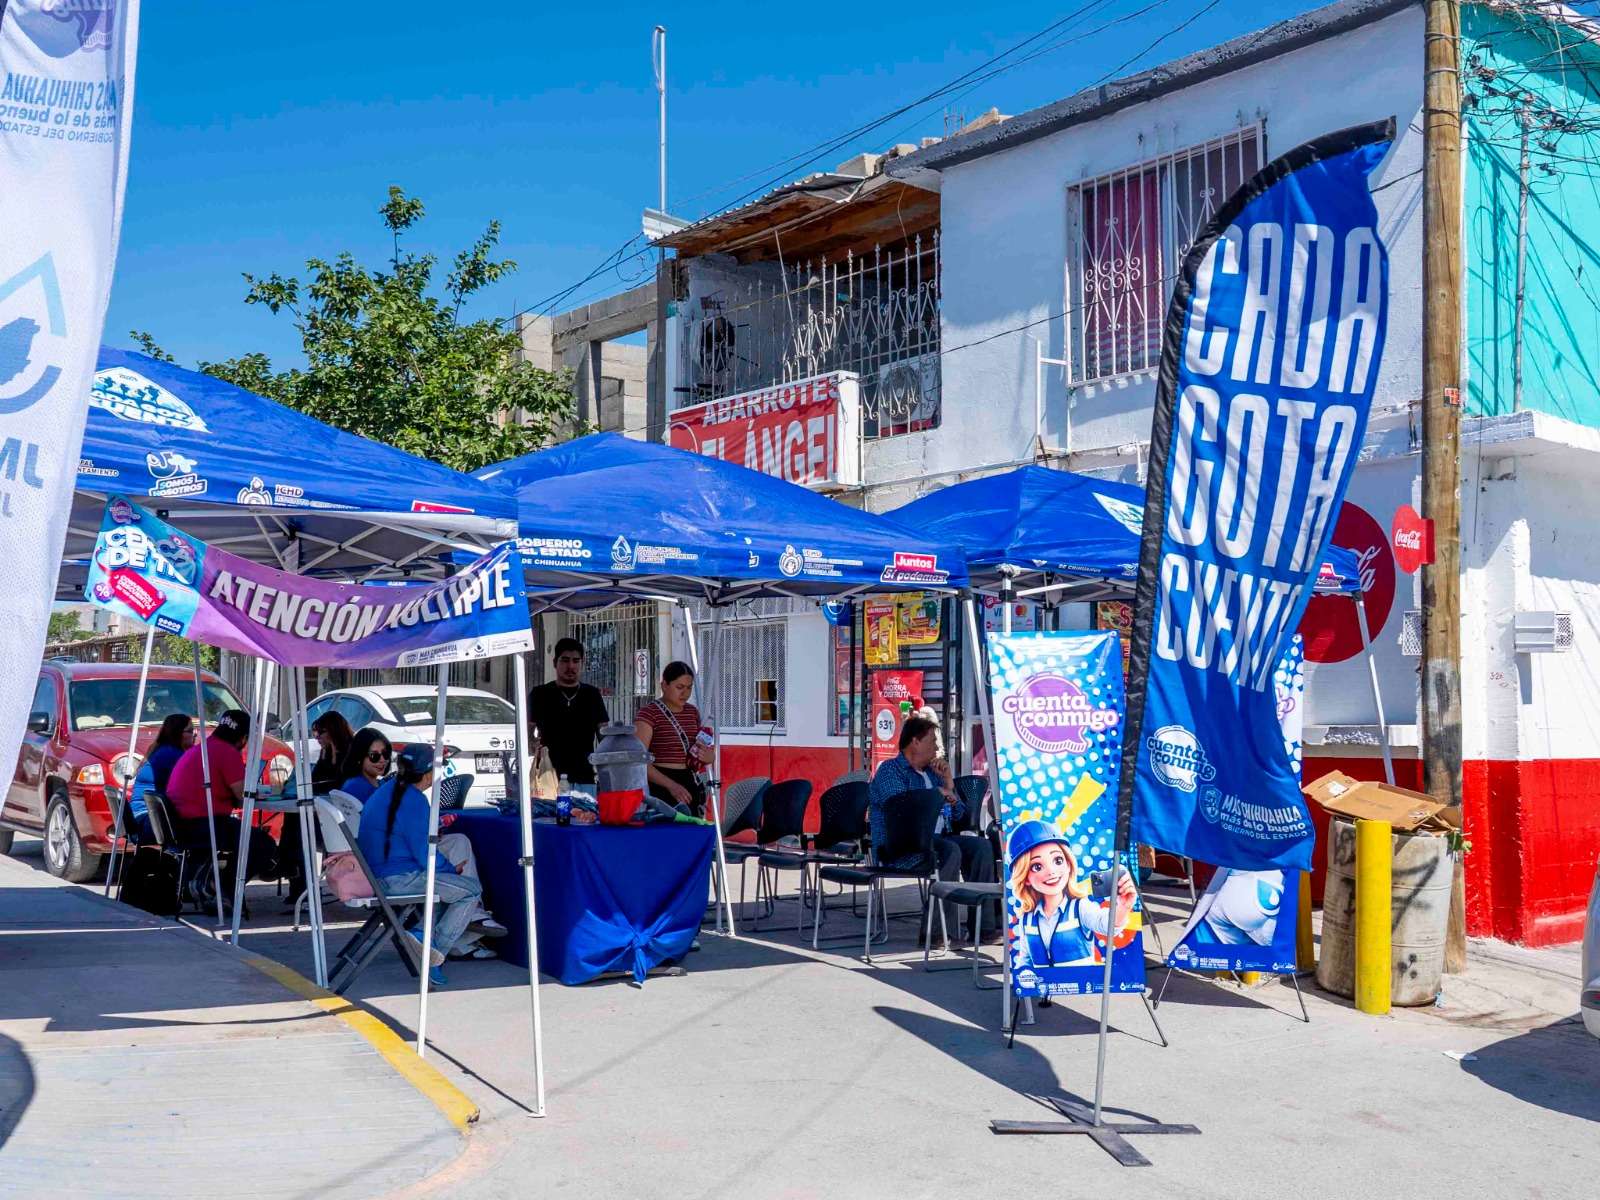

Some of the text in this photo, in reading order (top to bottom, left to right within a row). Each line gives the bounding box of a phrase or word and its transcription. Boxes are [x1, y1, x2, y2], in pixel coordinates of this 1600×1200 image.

[1185, 222, 1382, 394] CADA
[702, 374, 841, 427] ABARROTES
[744, 419, 839, 484] ÁNGEL
[1167, 385, 1358, 572] GOTA
[516, 538, 583, 549] GOBIERNO
[543, 548, 591, 558] ESTADO
[109, 549, 146, 568] DE
[522, 558, 582, 568] DE CHIHUAHUA
[897, 555, 932, 569] Juntos
[210, 570, 385, 643] ATENCIÓN
[1003, 692, 1092, 712] cuenta
[1019, 709, 1119, 731] conmigo
[1220, 812, 1242, 826] más
[1267, 822, 1306, 833] bueno
[1255, 832, 1271, 840] DEL
[1273, 830, 1308, 840] ESTADO
